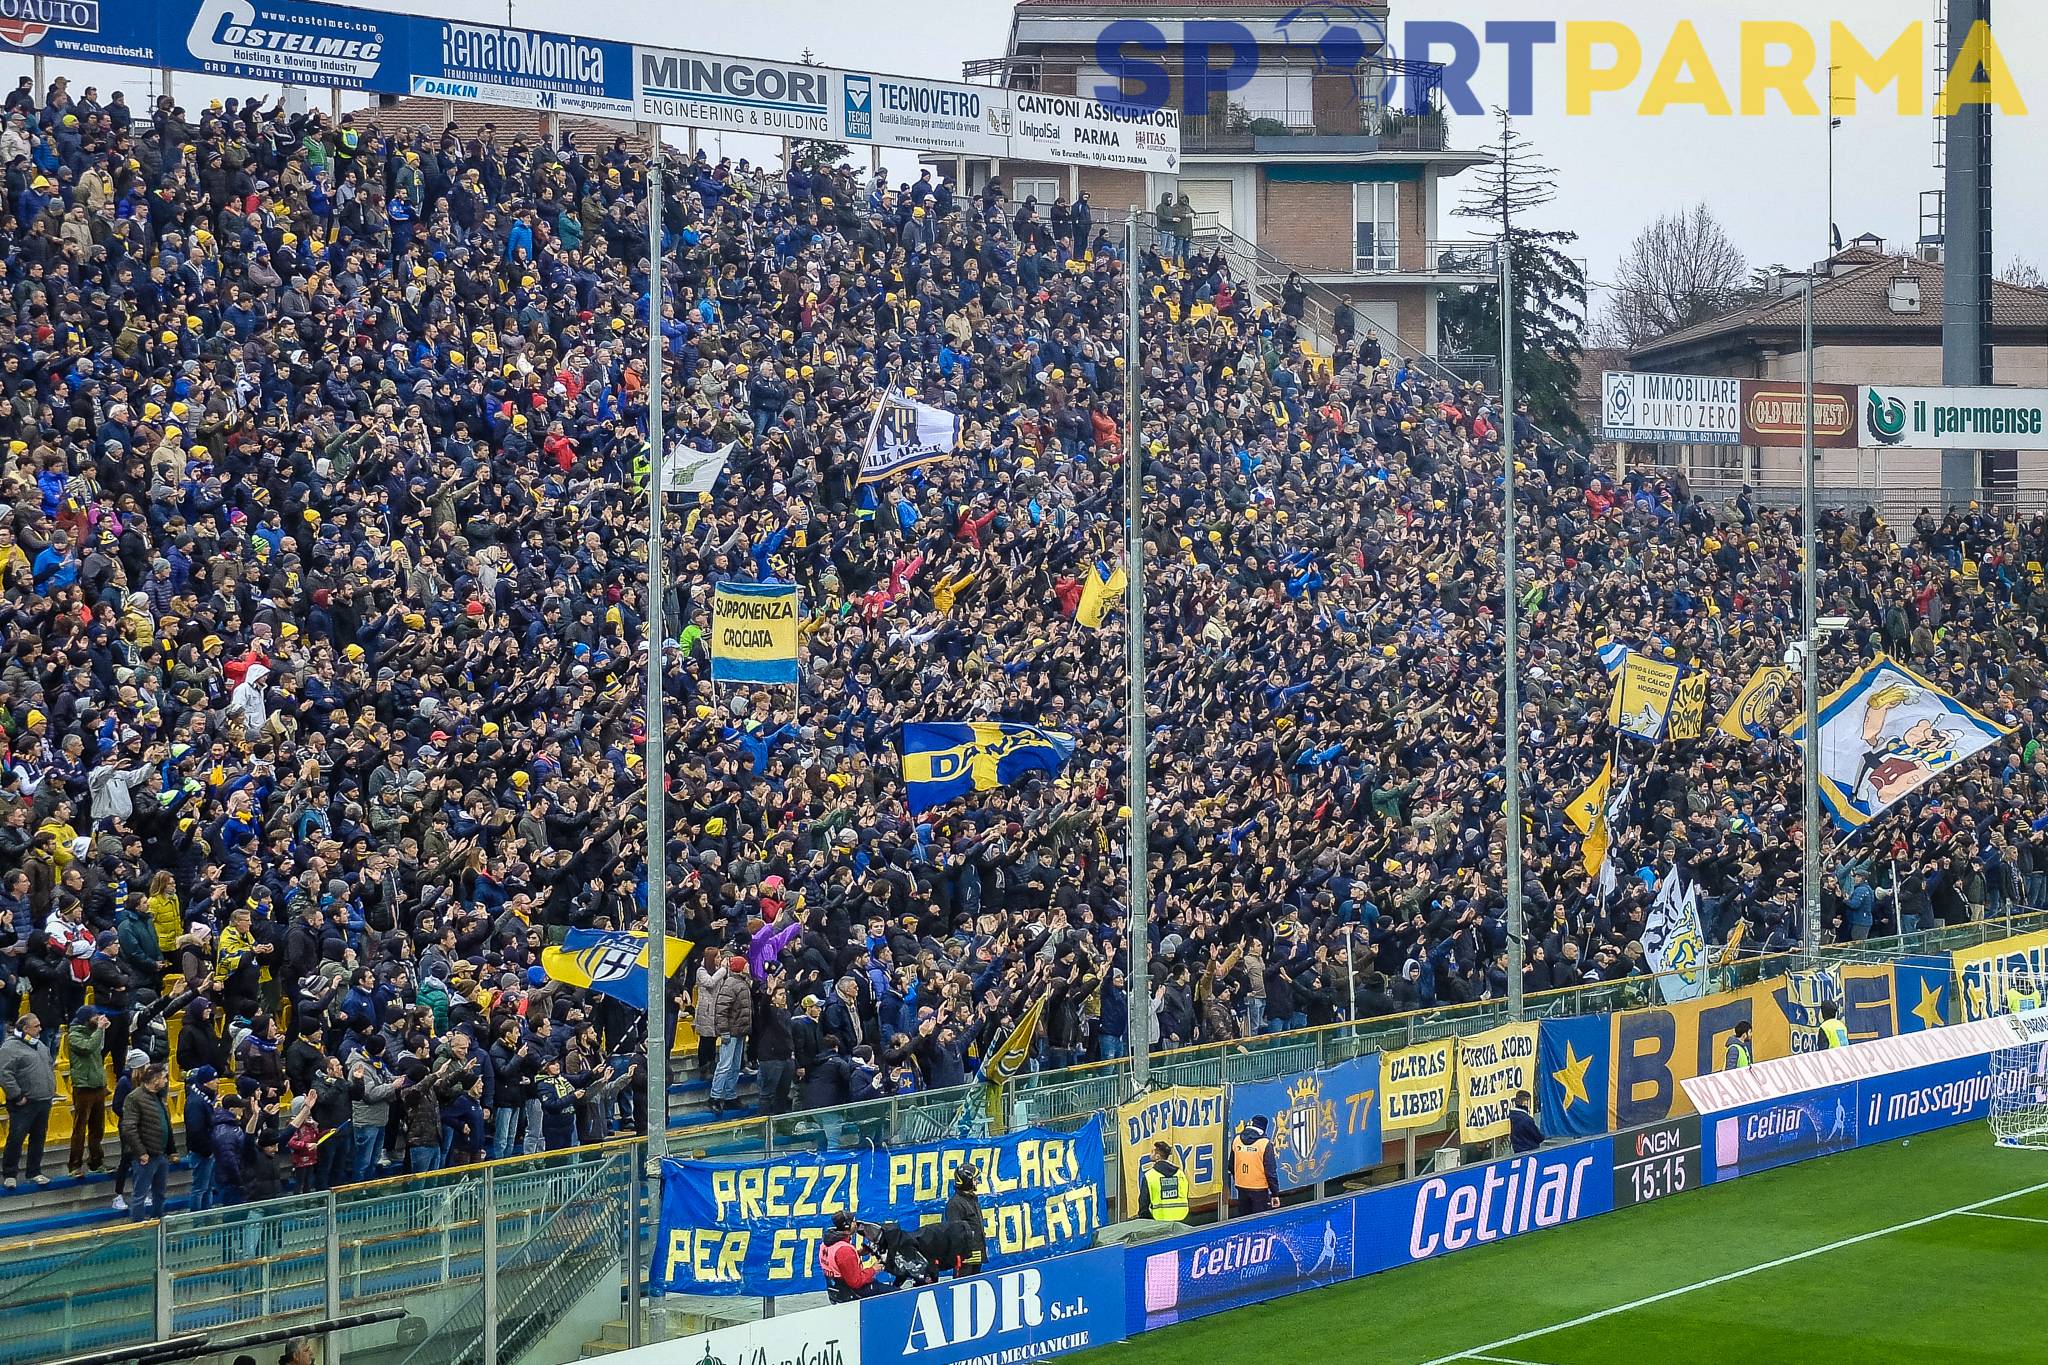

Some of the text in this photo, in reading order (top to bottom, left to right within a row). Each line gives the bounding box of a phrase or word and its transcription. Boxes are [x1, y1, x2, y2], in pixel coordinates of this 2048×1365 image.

[187, 0, 381, 60] COSTELMEC
[261, 11, 376, 32] www.costelmec.com
[55, 40, 153, 59] www.euroautosrl.it
[233, 49, 357, 75] Hoisting & Moving Industry
[204, 61, 363, 88] GRU A PONTE INDUSTRIALI
[425, 81, 478, 98] DAIKIN
[642, 54, 827, 105] MINGORI
[561, 96, 632, 112] www.grupporm.com
[643, 99, 828, 132] ENGINEERING & BUILDING
[879, 83, 980, 119] TECNOVETRO
[1017, 94, 1178, 129] CANTONI ASSICURATORI
[848, 122, 870, 135] VETRO
[895, 135, 965, 148] www.tecnovetrosrl.it
[1074, 127, 1120, 147] PARMA
[1146, 131, 1166, 146] ITAS
[1127, 155, 1148, 165] PARMA
[1643, 375, 1736, 404] IMMOBILIARE
[1642, 402, 1737, 429] PUNTO ZERO
[1756, 401, 1781, 424] OLD
[1913, 400, 2042, 438] il parmense
[716, 597, 793, 620] SUPPONENZA
[723, 628, 774, 648] CROCIATA
[1647, 677, 1670, 689] CALCIO
[1501, 1036, 1532, 1060] NORD
[1914, 1012, 2017, 1062] WAMPUM
[1390, 1049, 1446, 1082] ULTRAS
[1802, 1030, 1925, 1085] WAMPUM
[1683, 1055, 1812, 1110] WAMPUM
[1345, 1089, 1375, 1135] 77
[1389, 1088, 1444, 1118] LIBERI
[1868, 1092, 1882, 1127] il
[1887, 1070, 1991, 1122] massaggio
[1746, 1108, 1802, 1141] Cetilar
[1640, 1128, 1680, 1154] NGM
[712, 1164, 859, 1222] PREZZI
[1631, 1155, 1686, 1202] 15:15
[1409, 1156, 1593, 1259] Cetilar
[665, 1228, 750, 1282] PER
[1191, 1234, 1276, 1279] Cetilar
[902, 1268, 1089, 1356] ADR S.r.l.
[1000, 1331, 1089, 1364] MECCANICHE
